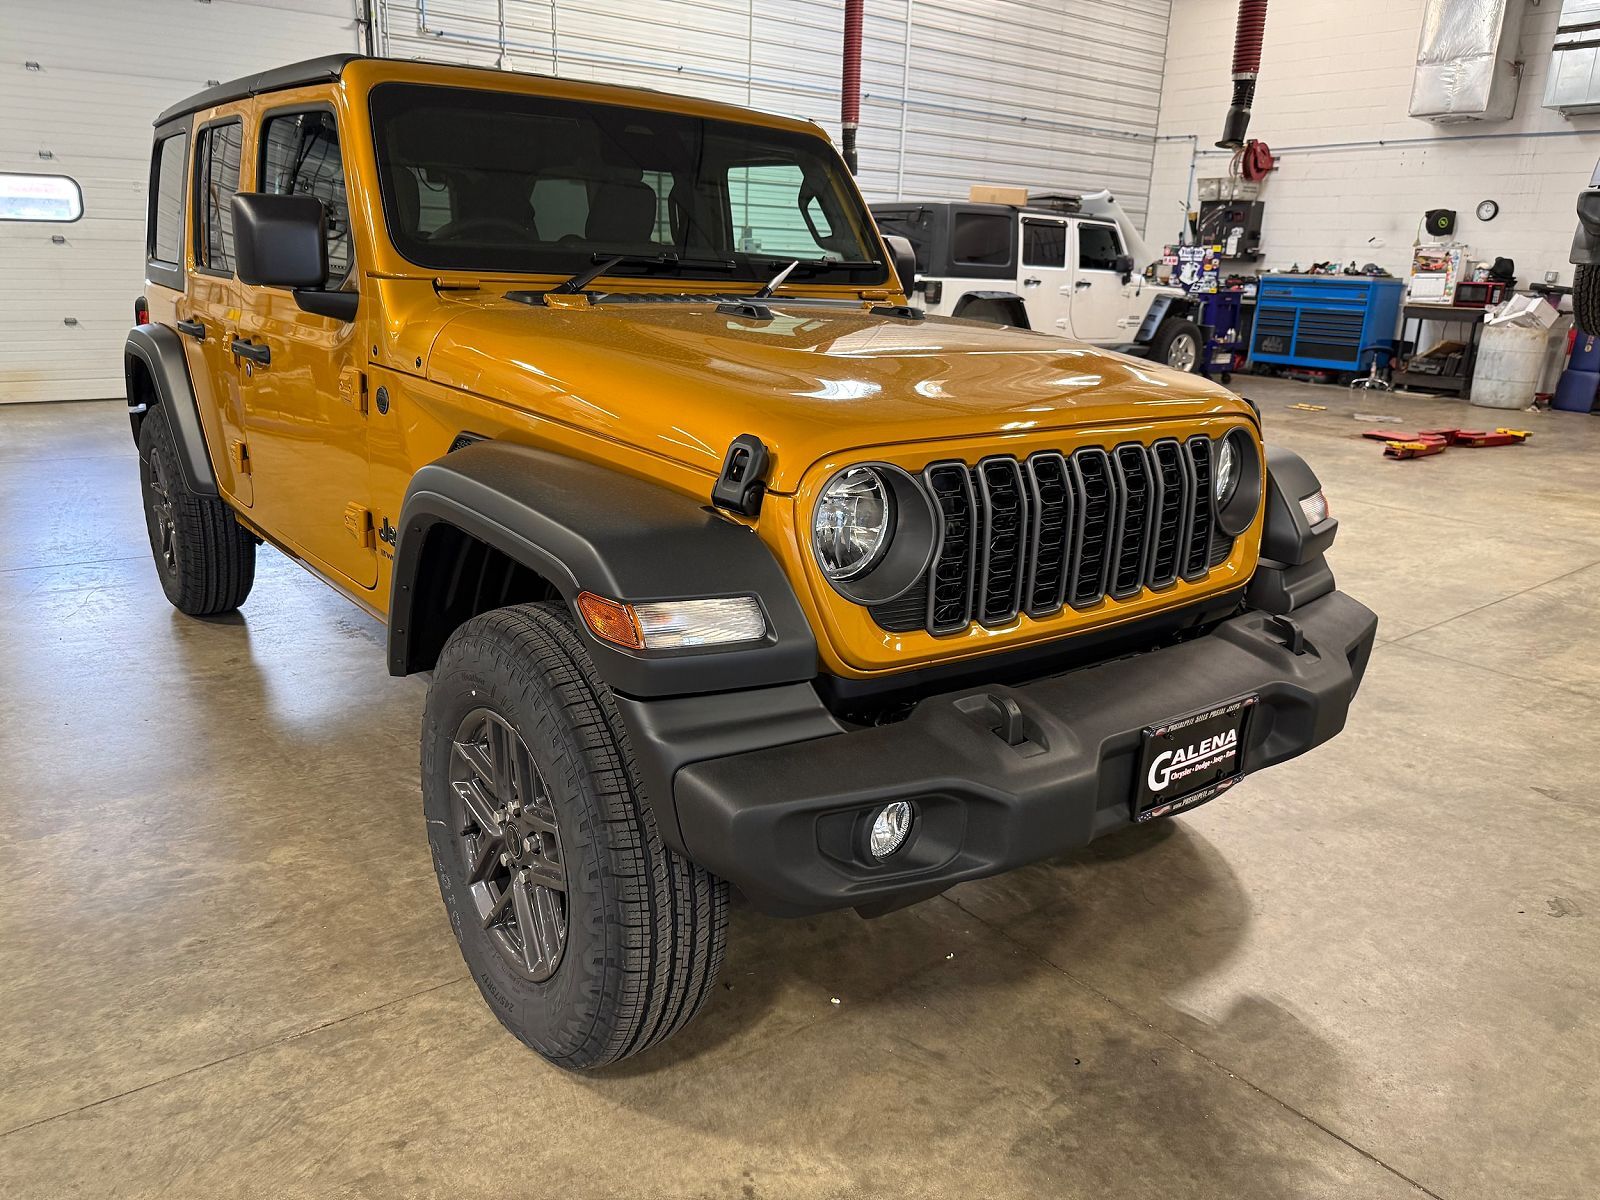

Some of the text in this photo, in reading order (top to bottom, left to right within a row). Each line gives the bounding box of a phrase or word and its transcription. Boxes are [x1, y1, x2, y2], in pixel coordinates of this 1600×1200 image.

[1209, 707, 1226, 719] POSTAL
[1227, 703, 1241, 713] JEEPS
[1147, 729, 1237, 791] GALENA
[1170, 749, 1236, 781] Chrysler Dodge Jeep Ram
